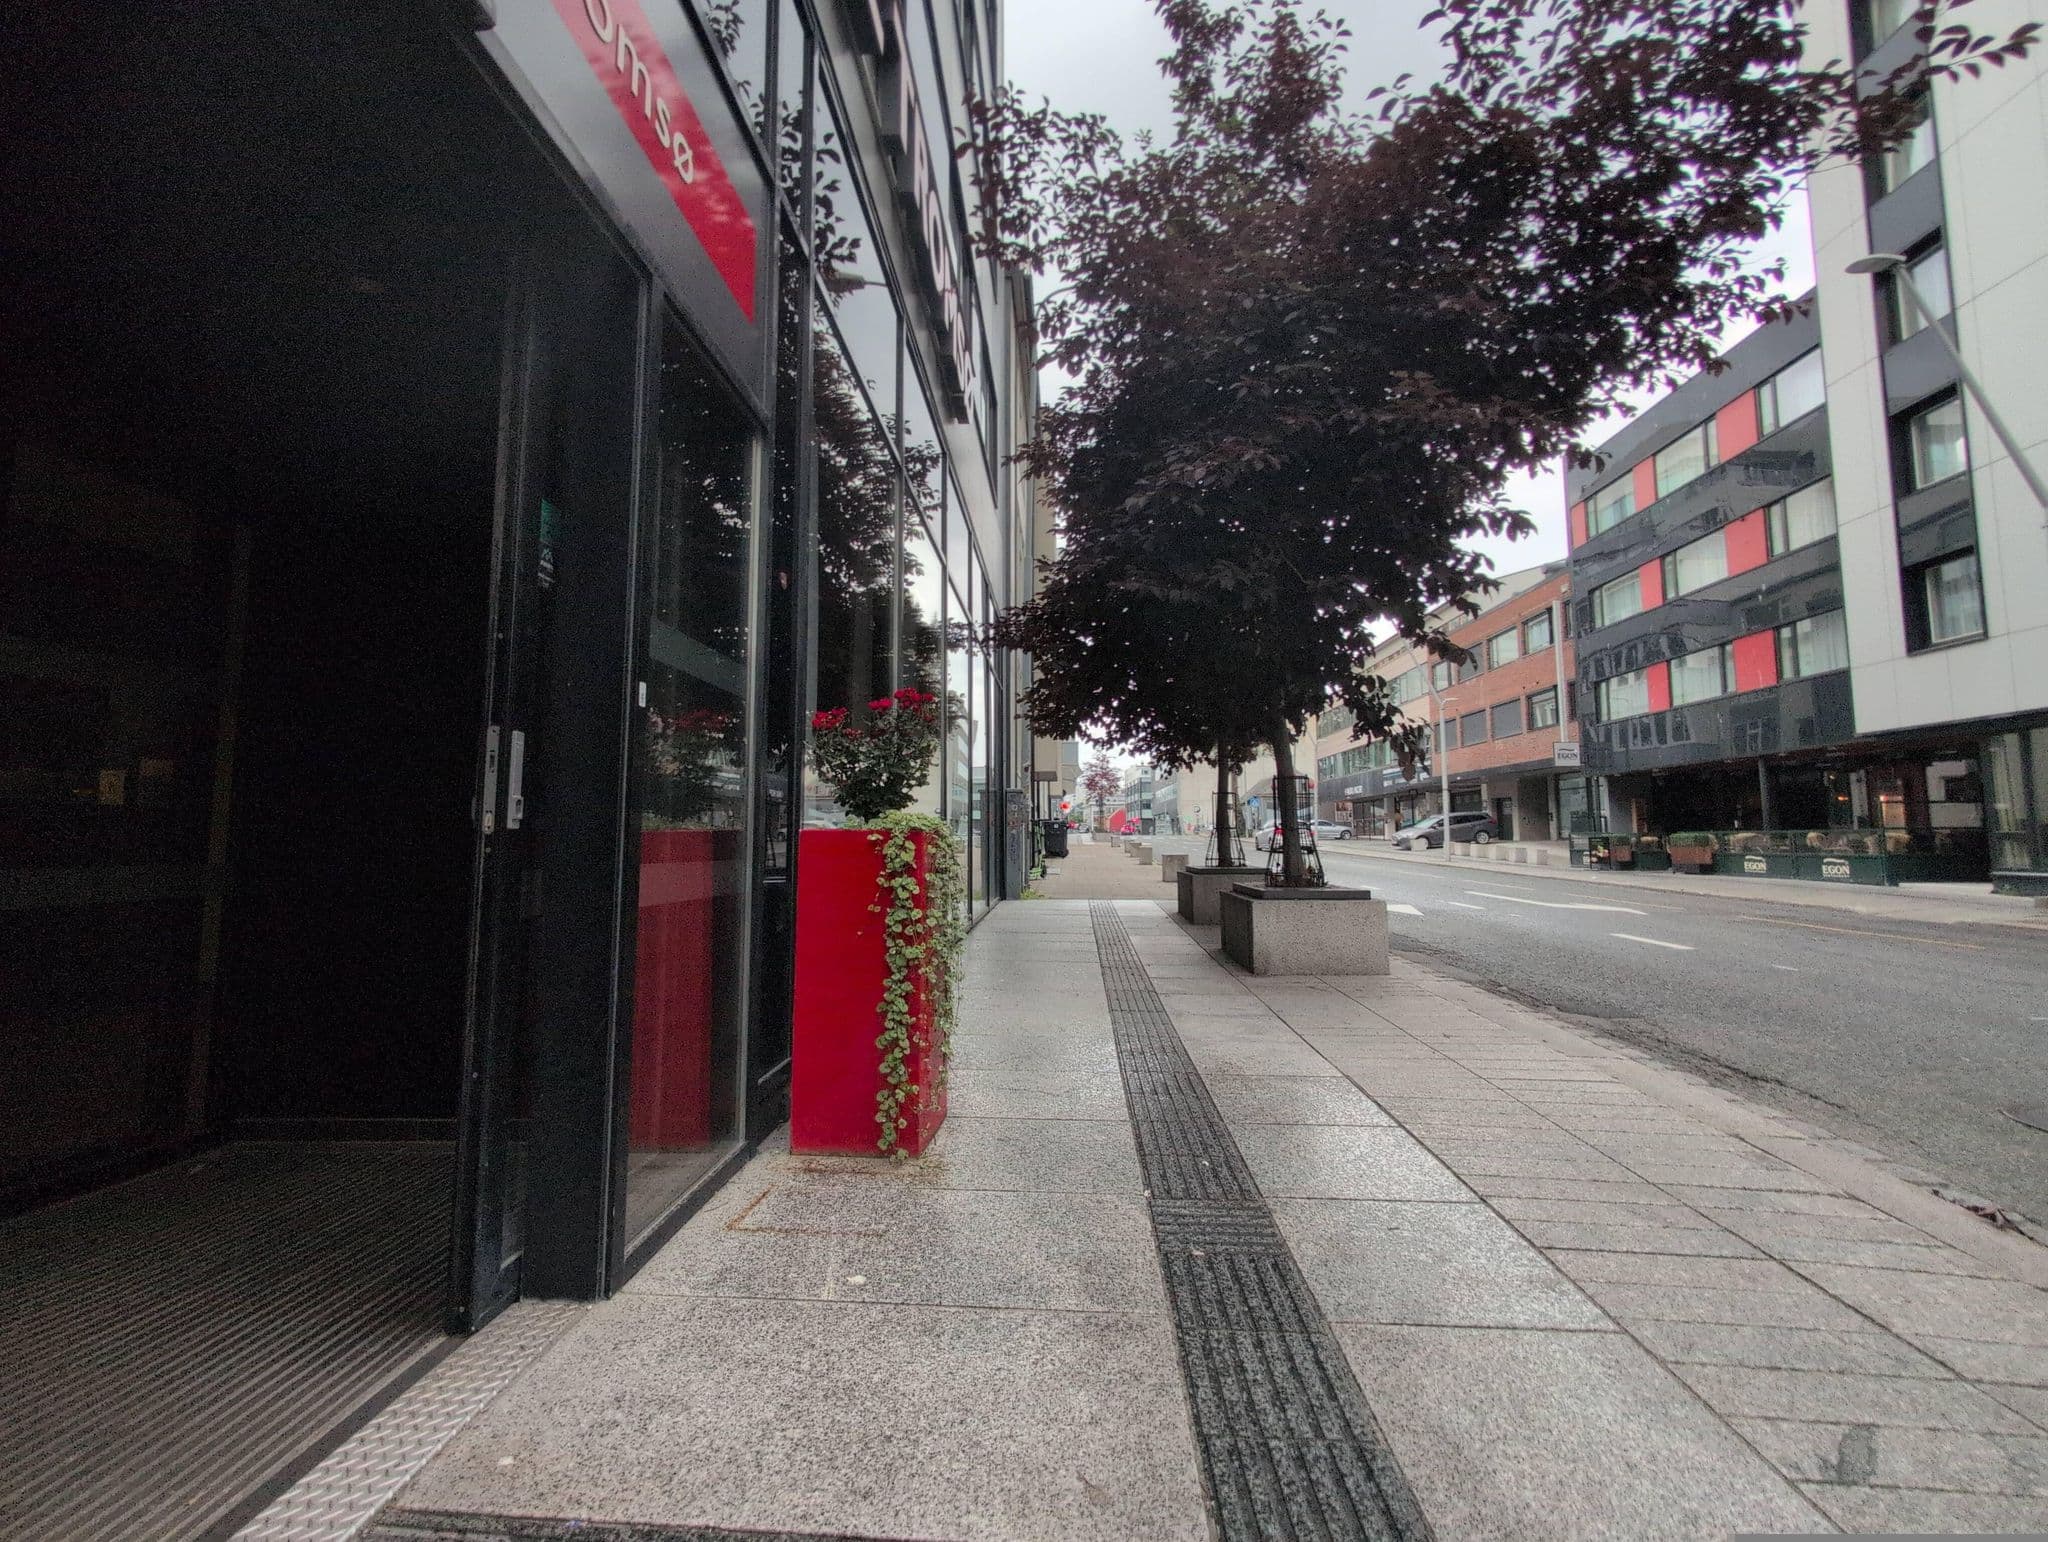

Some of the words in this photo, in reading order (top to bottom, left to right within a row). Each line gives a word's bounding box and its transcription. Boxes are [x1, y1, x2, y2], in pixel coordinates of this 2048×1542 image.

[1557, 752, 1579, 761] EGON
[1744, 861, 1767, 871] EGON
[1822, 864, 1850, 875] EGON
